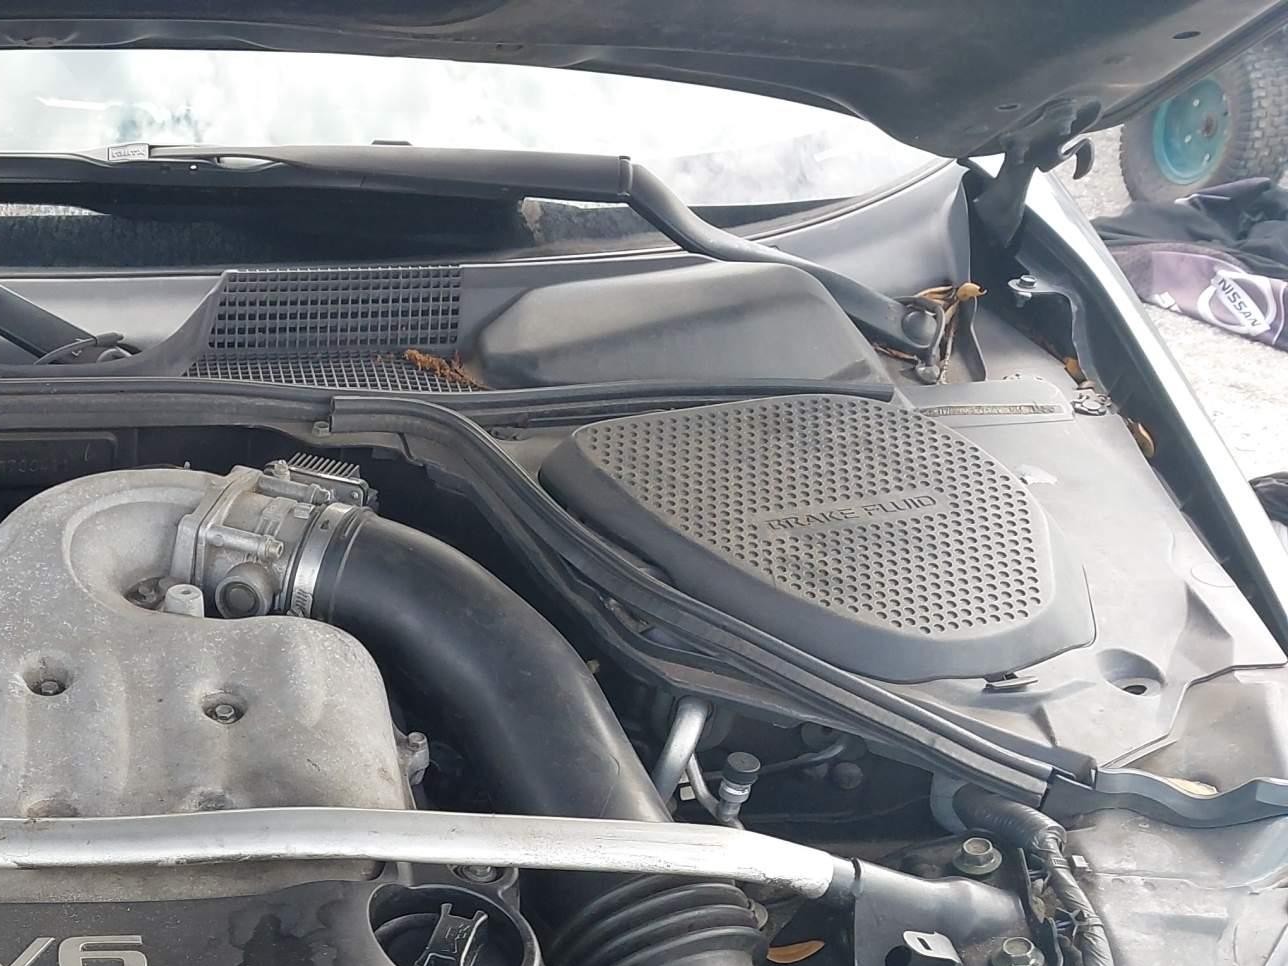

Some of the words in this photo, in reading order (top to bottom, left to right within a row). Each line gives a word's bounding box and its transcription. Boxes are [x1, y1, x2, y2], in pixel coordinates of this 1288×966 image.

[1218, 278, 1261, 327] NISSAN
[765, 508, 859, 530] BRAKE
[863, 495, 937, 516] FLUID
